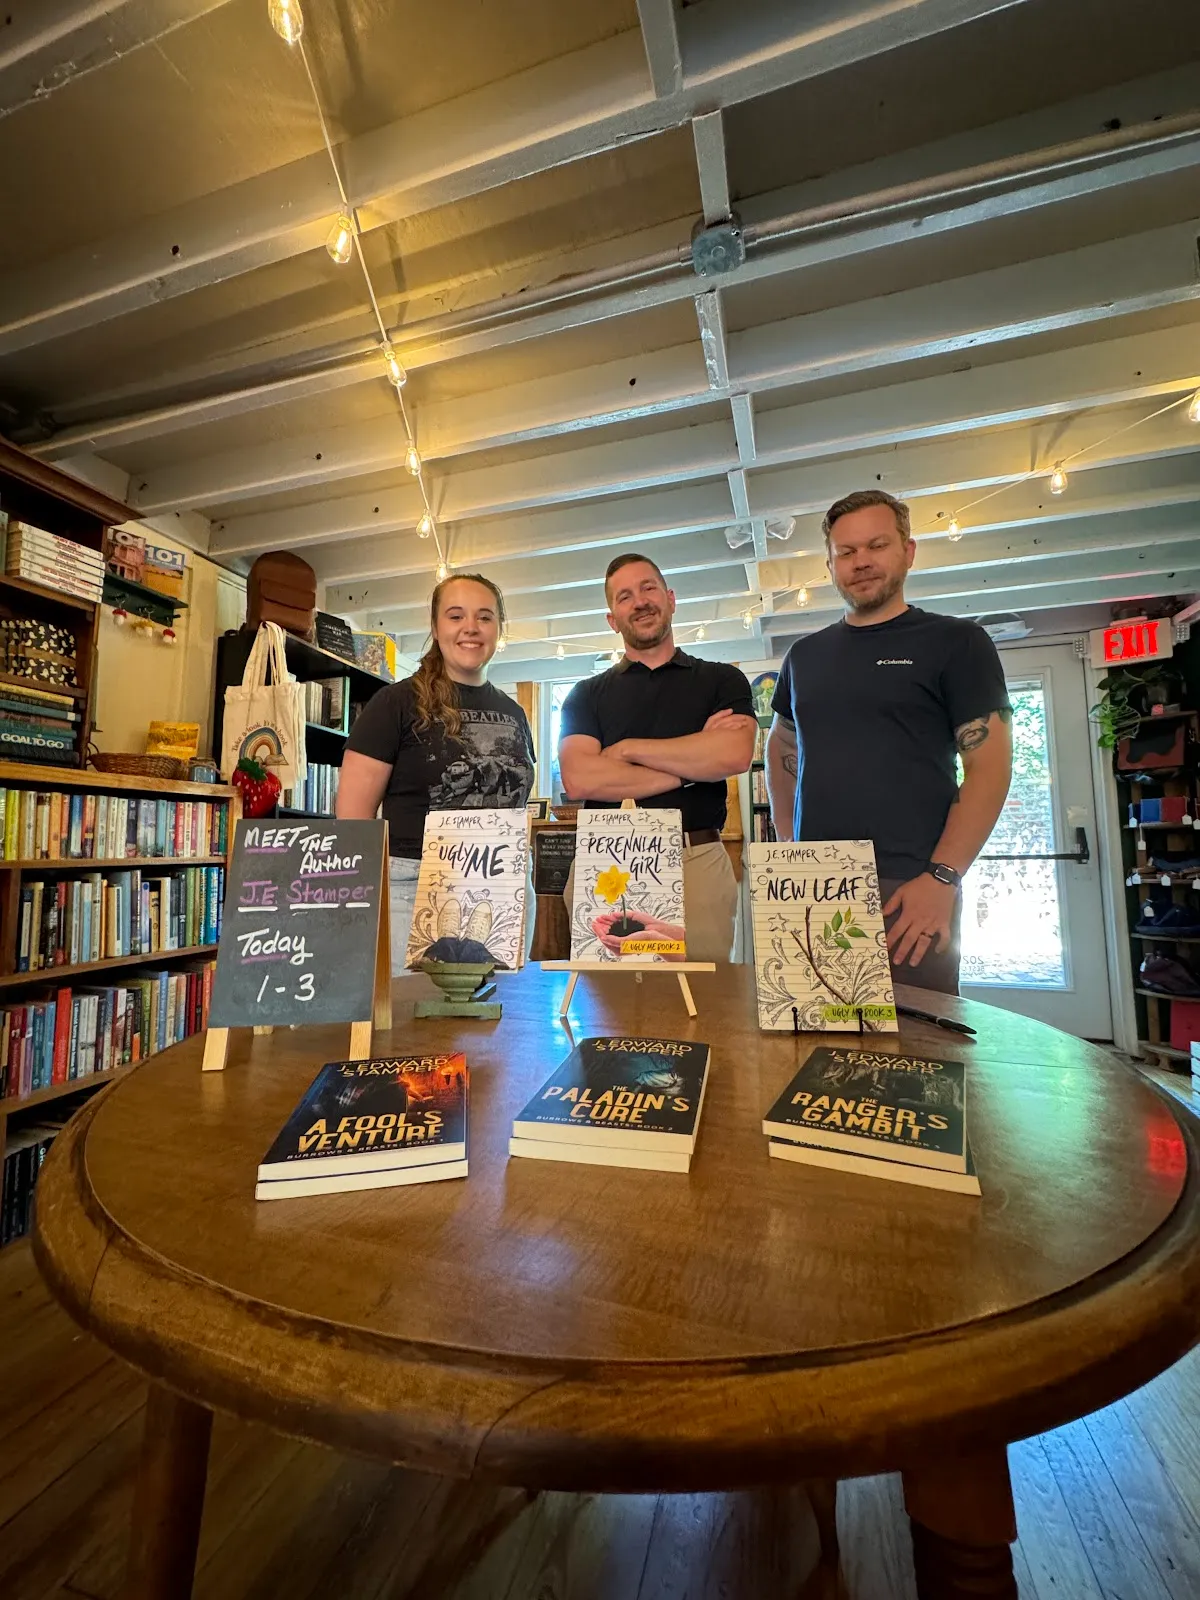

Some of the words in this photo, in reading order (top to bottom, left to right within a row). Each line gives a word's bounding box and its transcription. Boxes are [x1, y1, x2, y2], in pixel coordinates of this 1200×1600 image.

[107, 528, 145, 549] 101
[145, 546, 183, 565] 101
[1103, 621, 1160, 663] EXIT
[460, 711, 518, 727] BEATLES
[1, 733, 32, 745] GOAL
[32, 737, 46, 747] TO
[46, 740, 64, 749] GO
[231, 737, 242, 752] Take
[452, 815, 484, 830] STAMPER
[600, 813, 634, 826] STAMPER
[244, 826, 308, 848] MEET
[299, 833, 337, 852] THE
[587, 829, 667, 864] PERENNIAL
[300, 851, 362, 874] Author
[438, 841, 472, 870] UGLY
[464, 844, 510, 879] ME
[781, 848, 820, 864] STAMPER
[287, 879, 374, 903] Stamper
[767, 877, 806, 902] NEW
[813, 876, 864, 902] LEAF
[237, 928, 314, 965] Today
[630, 943, 646, 951] UGLY
[646, 942, 657, 952] ME
[657, 942, 674, 951] BOOK
[832, 1008, 850, 1019] UGLY
[864, 1008, 884, 1018] BOOK
[887, 1009, 892, 1017] 3
[595, 1045, 684, 1057] STAMPER
[608, 1040, 693, 1052] EDWARD
[357, 1059, 448, 1072] EDWARD
[833, 1056, 935, 1075] STAMPER
[847, 1052, 944, 1070] EDWARD
[342, 1065, 441, 1078] STAMPER
[541, 1086, 690, 1112] PALADIN'S
[861, 1096, 879, 1105] THE
[536, 1115, 582, 1123] BURROWS
[569, 1103, 648, 1123] CURE
[791, 1091, 949, 1130] RANGER'S
[304, 1119, 327, 1136] A
[336, 1110, 443, 1134] FOOL'S
[785, 1118, 835, 1130] BURROWS
[898, 1138, 930, 1147] BOOK
[801, 1108, 927, 1141] GAMBIT
[298, 1123, 444, 1152] VENTURE
[286, 1150, 343, 1160] BURROWS
[358, 1143, 402, 1152] BEASTS:
